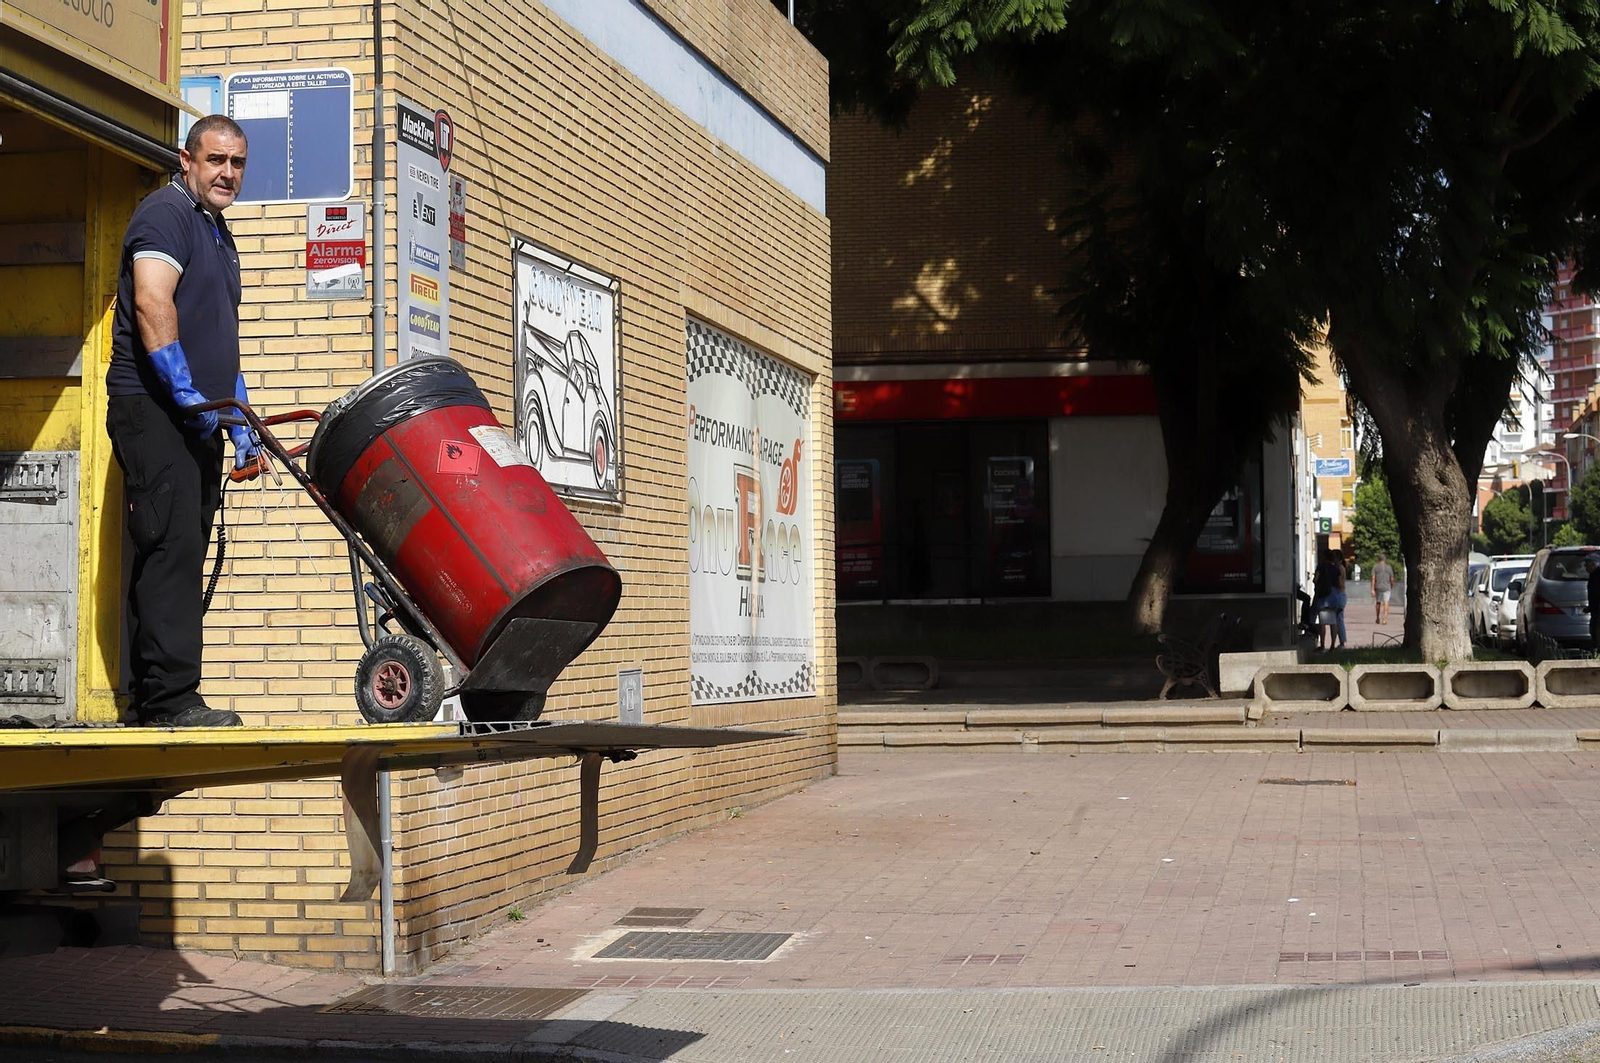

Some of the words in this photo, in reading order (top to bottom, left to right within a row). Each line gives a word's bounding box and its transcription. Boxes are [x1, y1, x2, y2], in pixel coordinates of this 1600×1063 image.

[56, 0, 114, 28] OCIO
[416, 169, 429, 185] NEXEN
[430, 175, 439, 189] TIRE
[316, 219, 358, 238] Direct
[309, 244, 363, 257] Alarma
[415, 245, 439, 264] MICHELIN
[411, 273, 438, 302] PIRELLI
[410, 314, 440, 332] GOODYEAR
